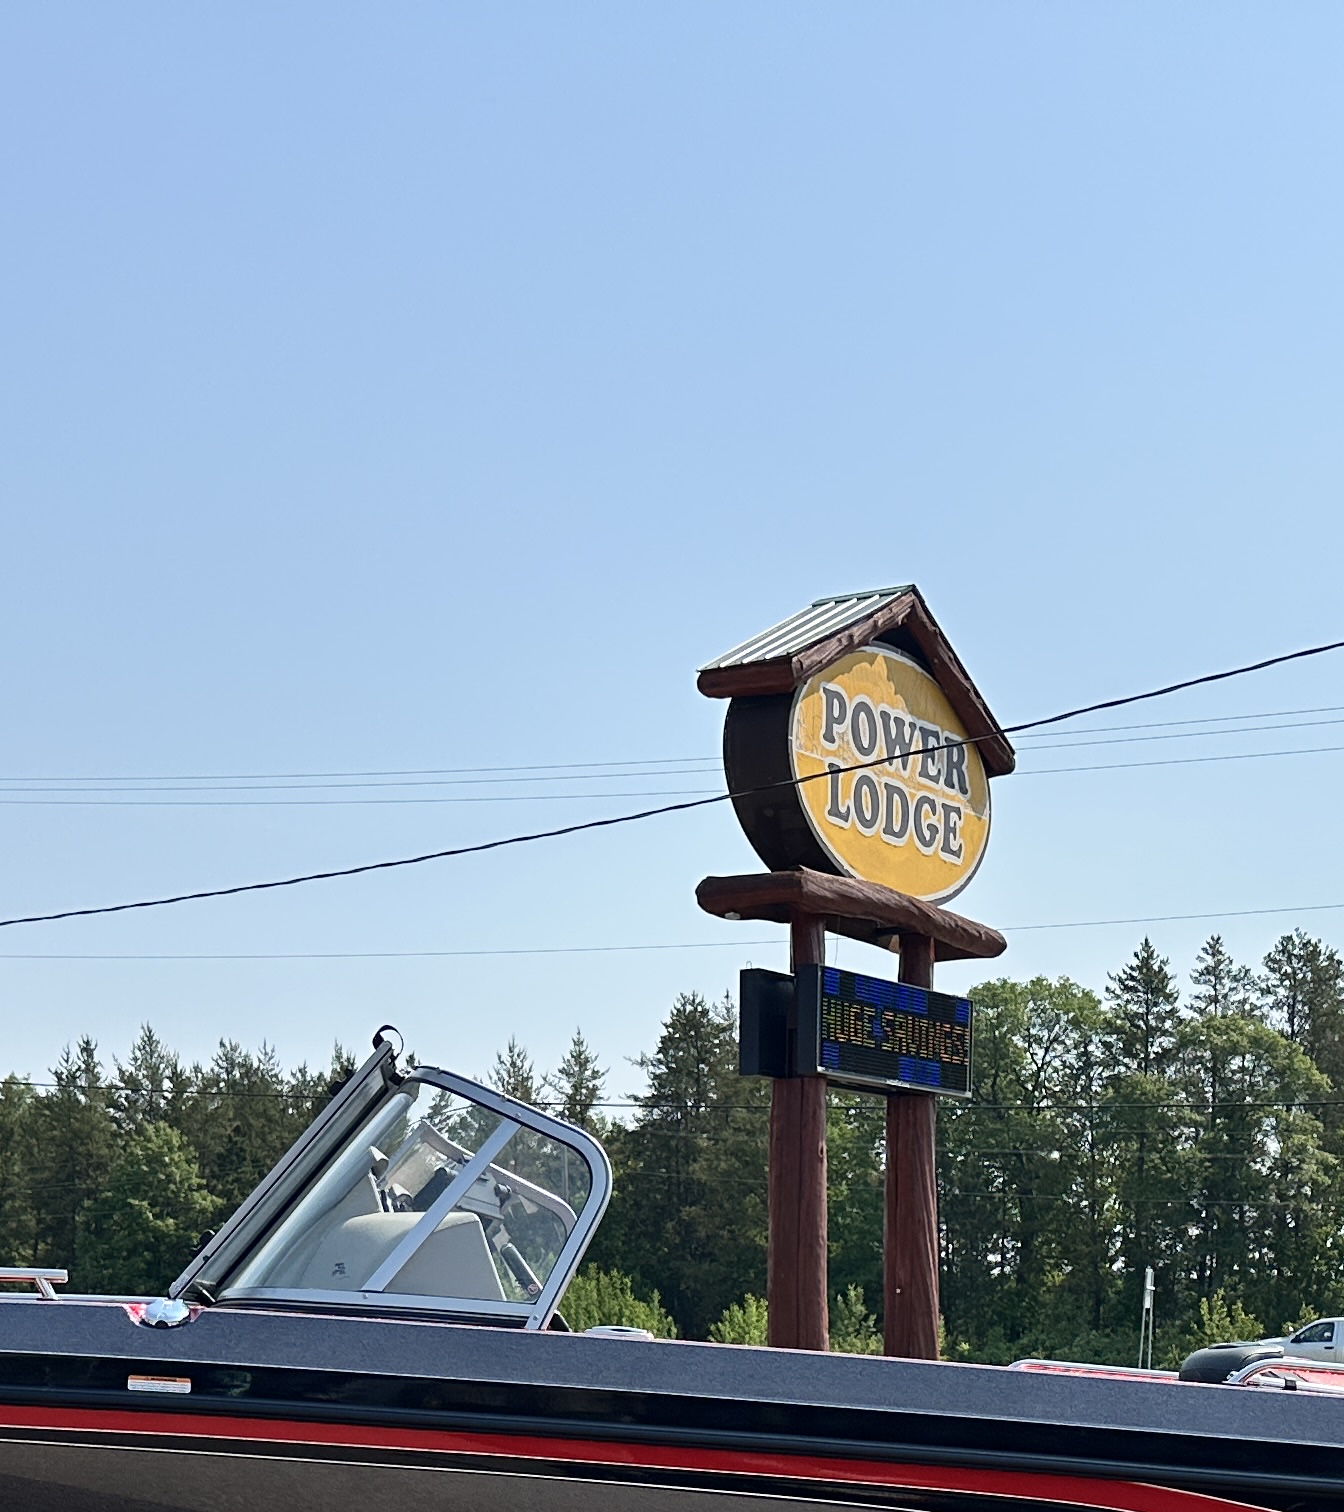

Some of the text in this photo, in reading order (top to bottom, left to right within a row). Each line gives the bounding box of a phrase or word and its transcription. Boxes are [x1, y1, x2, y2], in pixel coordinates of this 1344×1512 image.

[822, 687, 968, 796] POWER
[828, 762, 963, 860] LODGE
[822, 997, 876, 1048] HUGE
